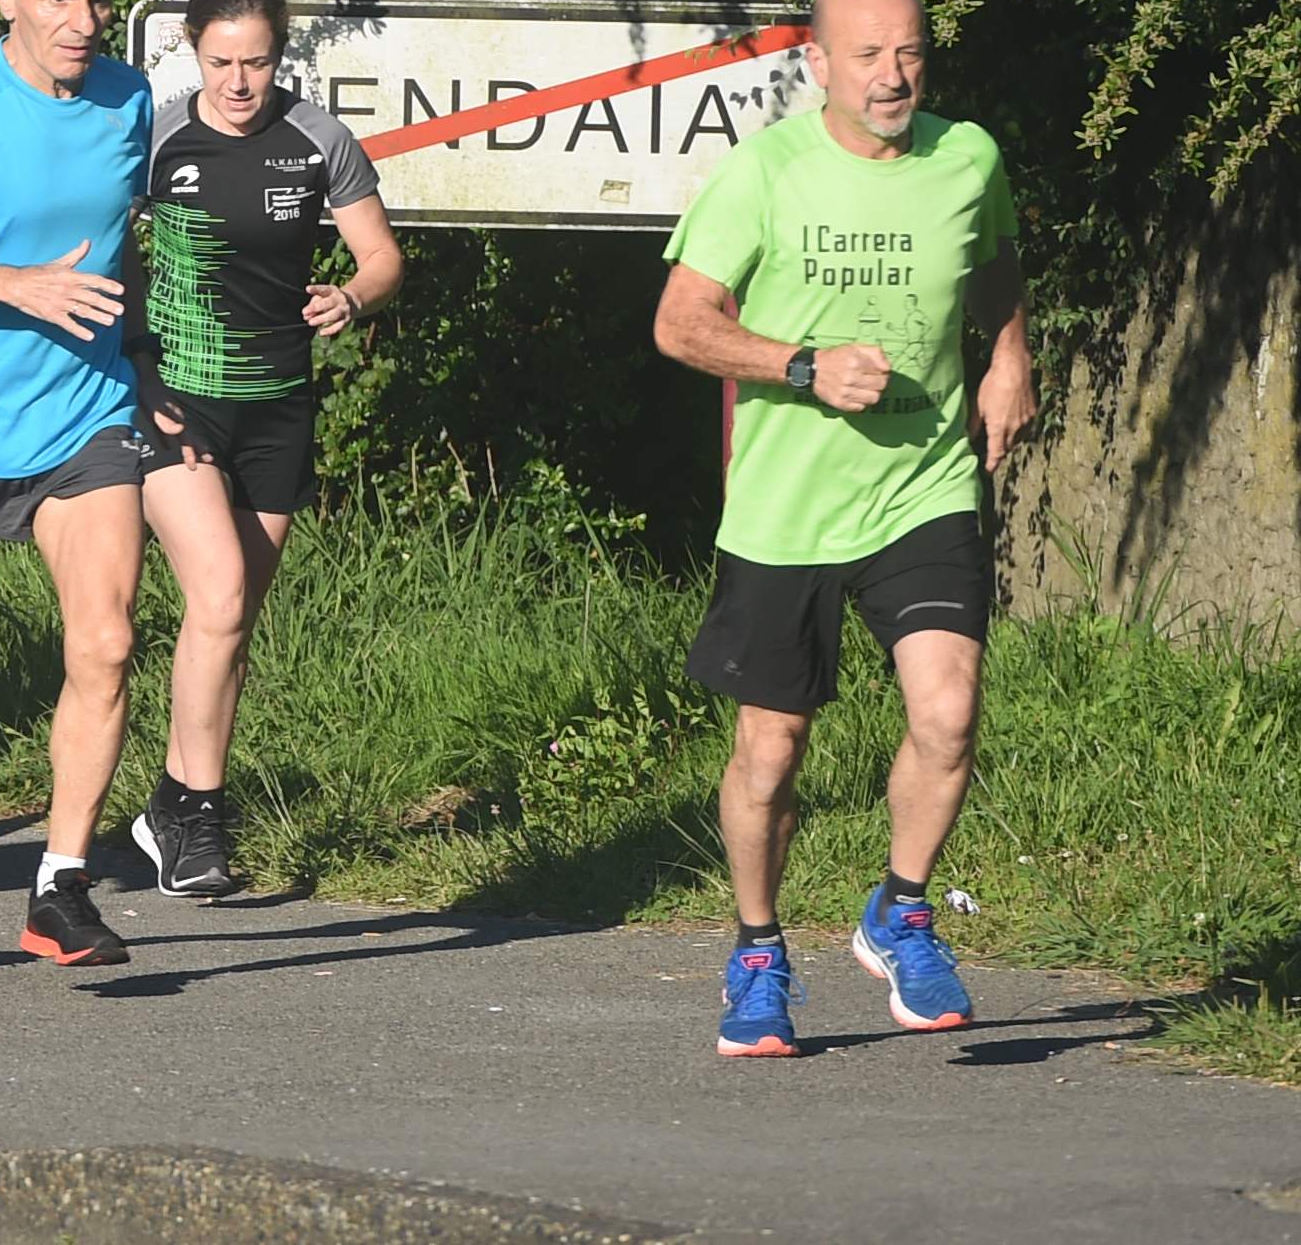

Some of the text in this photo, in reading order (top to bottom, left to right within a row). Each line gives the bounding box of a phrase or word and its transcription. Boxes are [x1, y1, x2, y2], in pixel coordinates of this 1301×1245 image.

[292, 75, 740, 155] ENDAIA
[264, 157, 306, 167] ALKAIN
[273, 207, 301, 221] 2016
[803, 225, 913, 253] I Carrera
[804, 258, 914, 294] Popular
